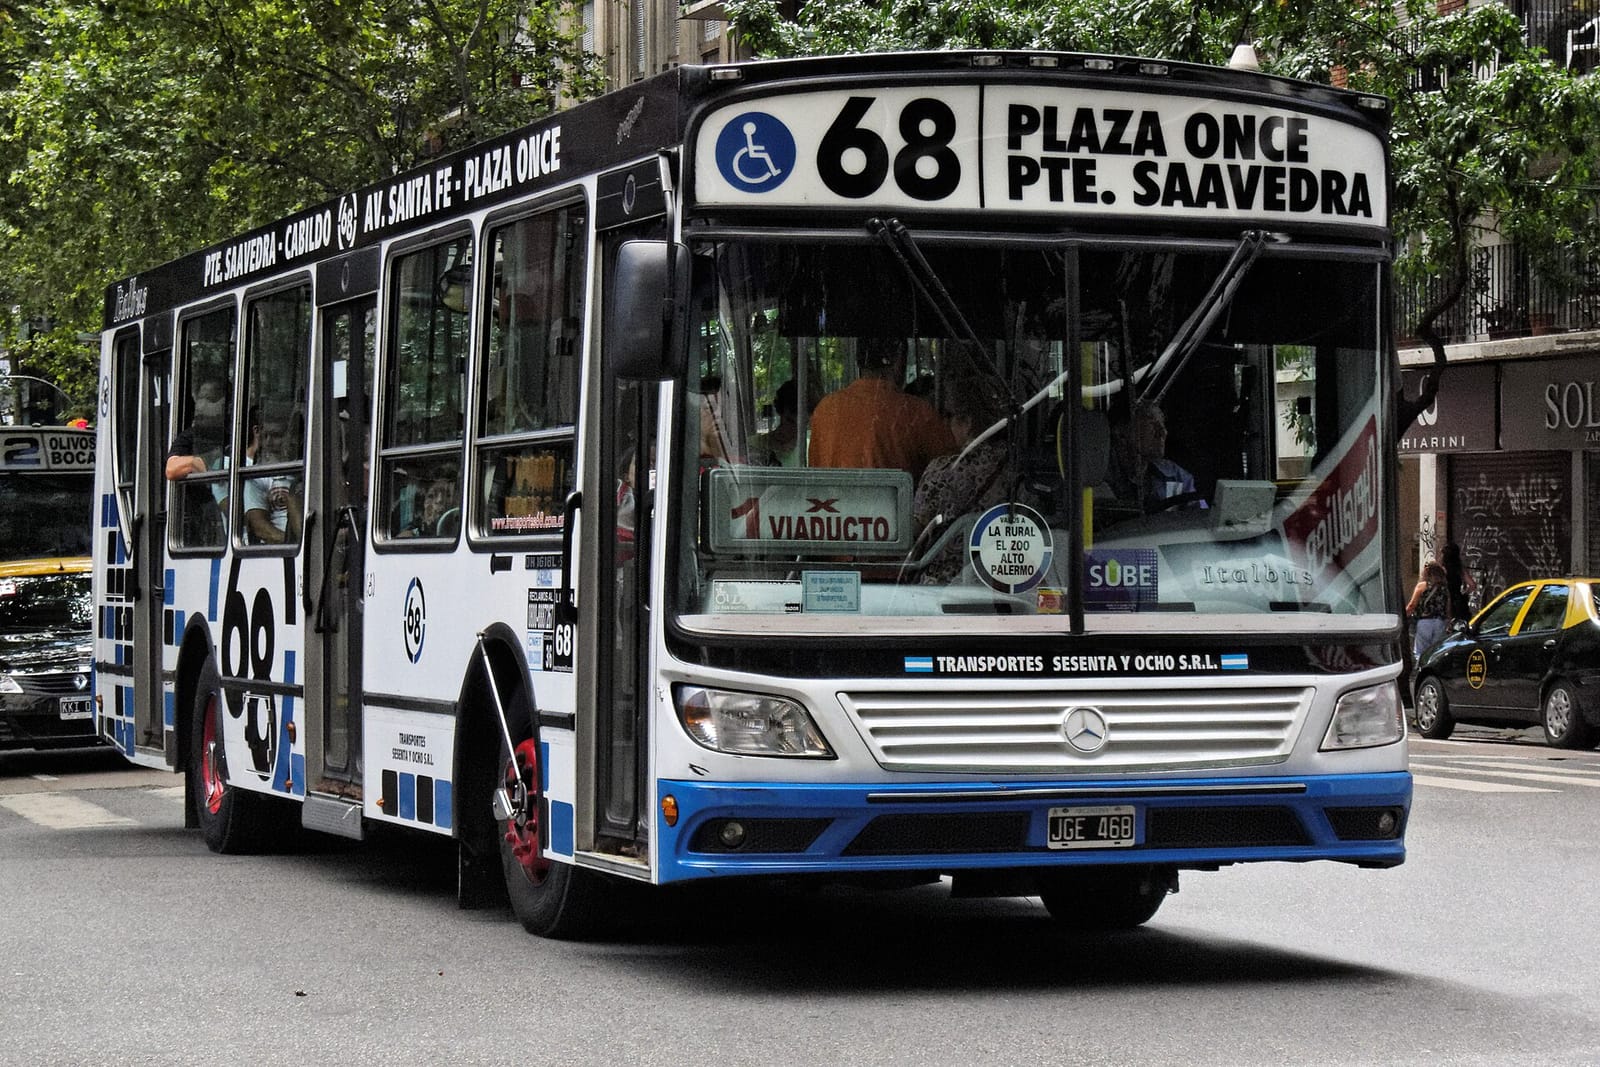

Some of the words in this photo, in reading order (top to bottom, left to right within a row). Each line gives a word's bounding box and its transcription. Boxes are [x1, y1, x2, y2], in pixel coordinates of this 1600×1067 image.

[1008, 104, 1168, 157] PLAZA
[1184, 112, 1308, 163] ONCE
[817, 97, 961, 201] 68
[364, 190, 385, 233] AV.
[388, 174, 432, 226] SANTA
[435, 166, 452, 211] FE
[464, 145, 512, 201] PLAZA
[516, 126, 561, 184] ONCE
[1008, 155, 1116, 205] PTE.
[1133, 160, 1372, 218] SAAVEDRA
[204, 251, 222, 287] PTE.
[224, 231, 276, 281] SAAVEDRA
[284, 209, 332, 260] CABILDO
[1545, 381, 1600, 429] SOL
[4, 437, 40, 465] 2
[49, 437, 96, 450] OLIVOS
[1397, 435, 1465, 449] HIARINI
[51, 451, 96, 464] BOCA
[731, 498, 760, 540] 1
[769, 516, 889, 541] VIADUCTO
[989, 526, 1001, 537] LA
[1005, 526, 1036, 537] RURAL
[996, 540, 1007, 551] EL
[1011, 541, 1030, 551] ZOO
[991, 565, 1034, 576] PALERMO
[1000, 553, 1024, 564] ALTO
[1090, 564, 1153, 587] SUBE
[1203, 563, 1314, 586] Italbus
[407, 597, 421, 645] 68
[556, 624, 571, 656] 68
[221, 558, 278, 781] 68
[936, 656, 1044, 672] TRANSPORTES
[1052, 655, 1118, 672] SESENTA
[1120, 655, 1131, 670] Y
[1134, 655, 1175, 671] OCHO
[1179, 654, 1218, 670] S.R.L.
[62, 701, 80, 713] KKI
[1051, 817, 1086, 841] JGE
[1098, 816, 1132, 839] 468
